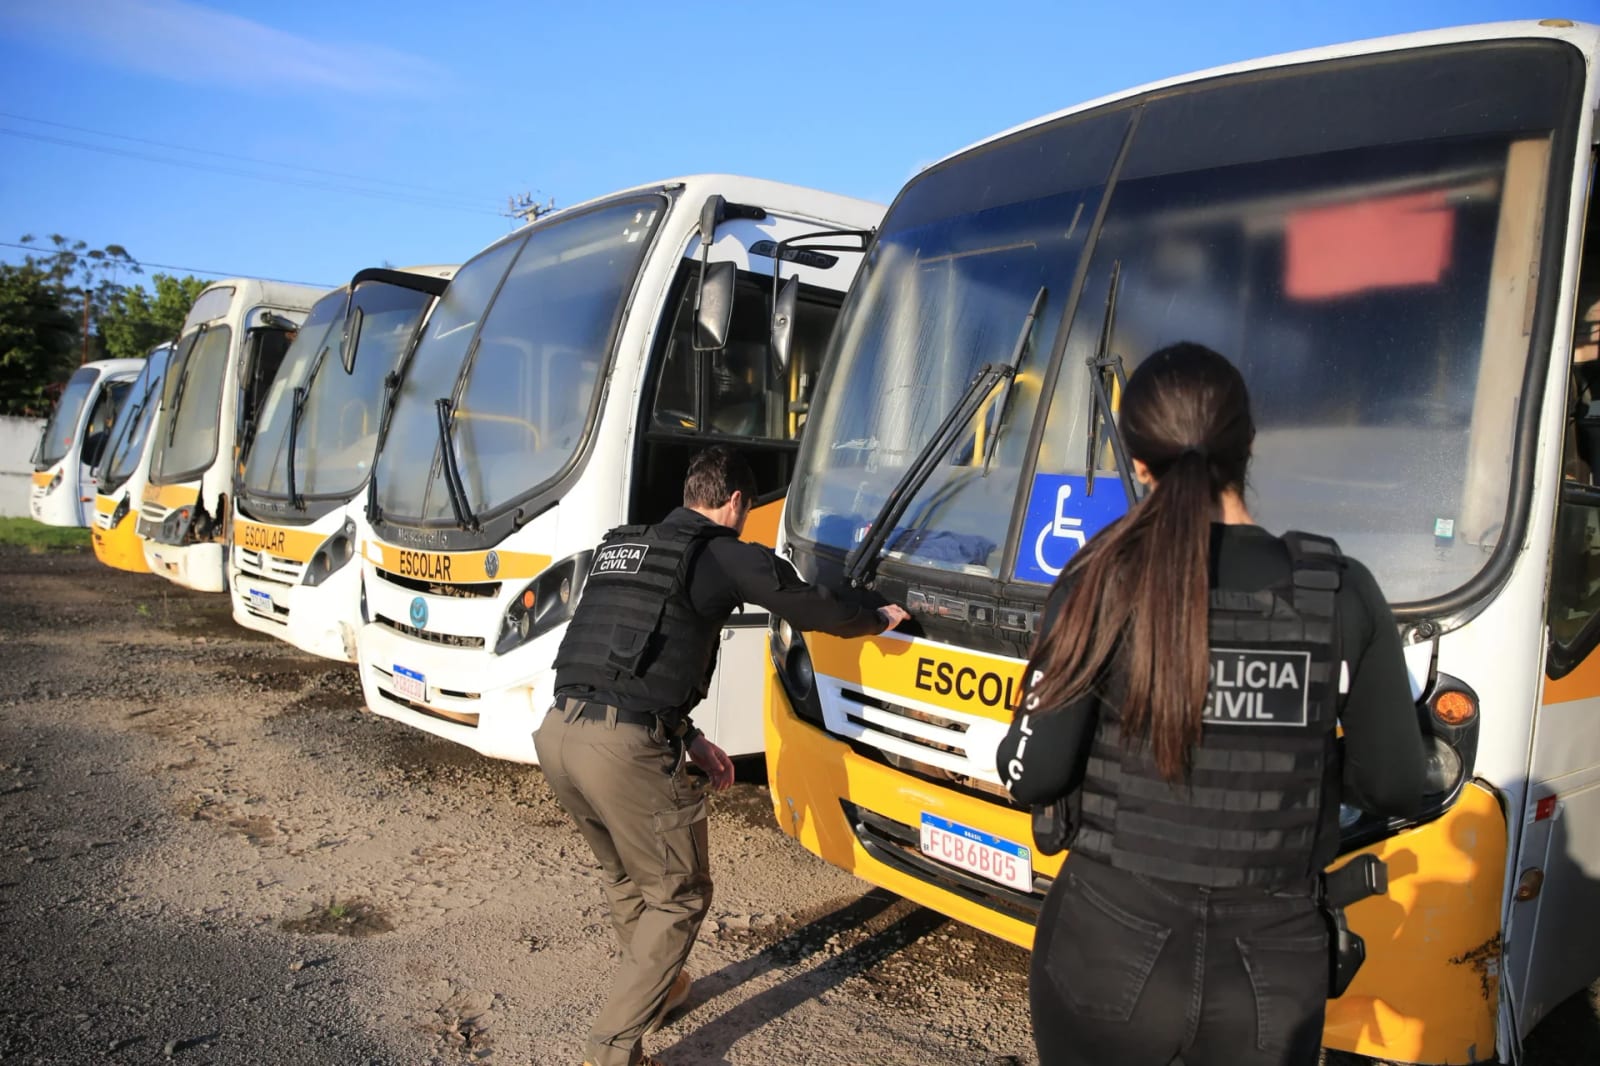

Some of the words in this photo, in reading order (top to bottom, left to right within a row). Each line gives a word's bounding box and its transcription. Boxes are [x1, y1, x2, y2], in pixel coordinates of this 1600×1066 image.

[245, 526, 285, 552] ESCOLAR
[400, 551, 451, 581] ESCOLAR
[599, 547, 640, 561] POLÍCIA
[600, 559, 627, 570] CIVIL
[930, 829, 1016, 882] FCB6B05
